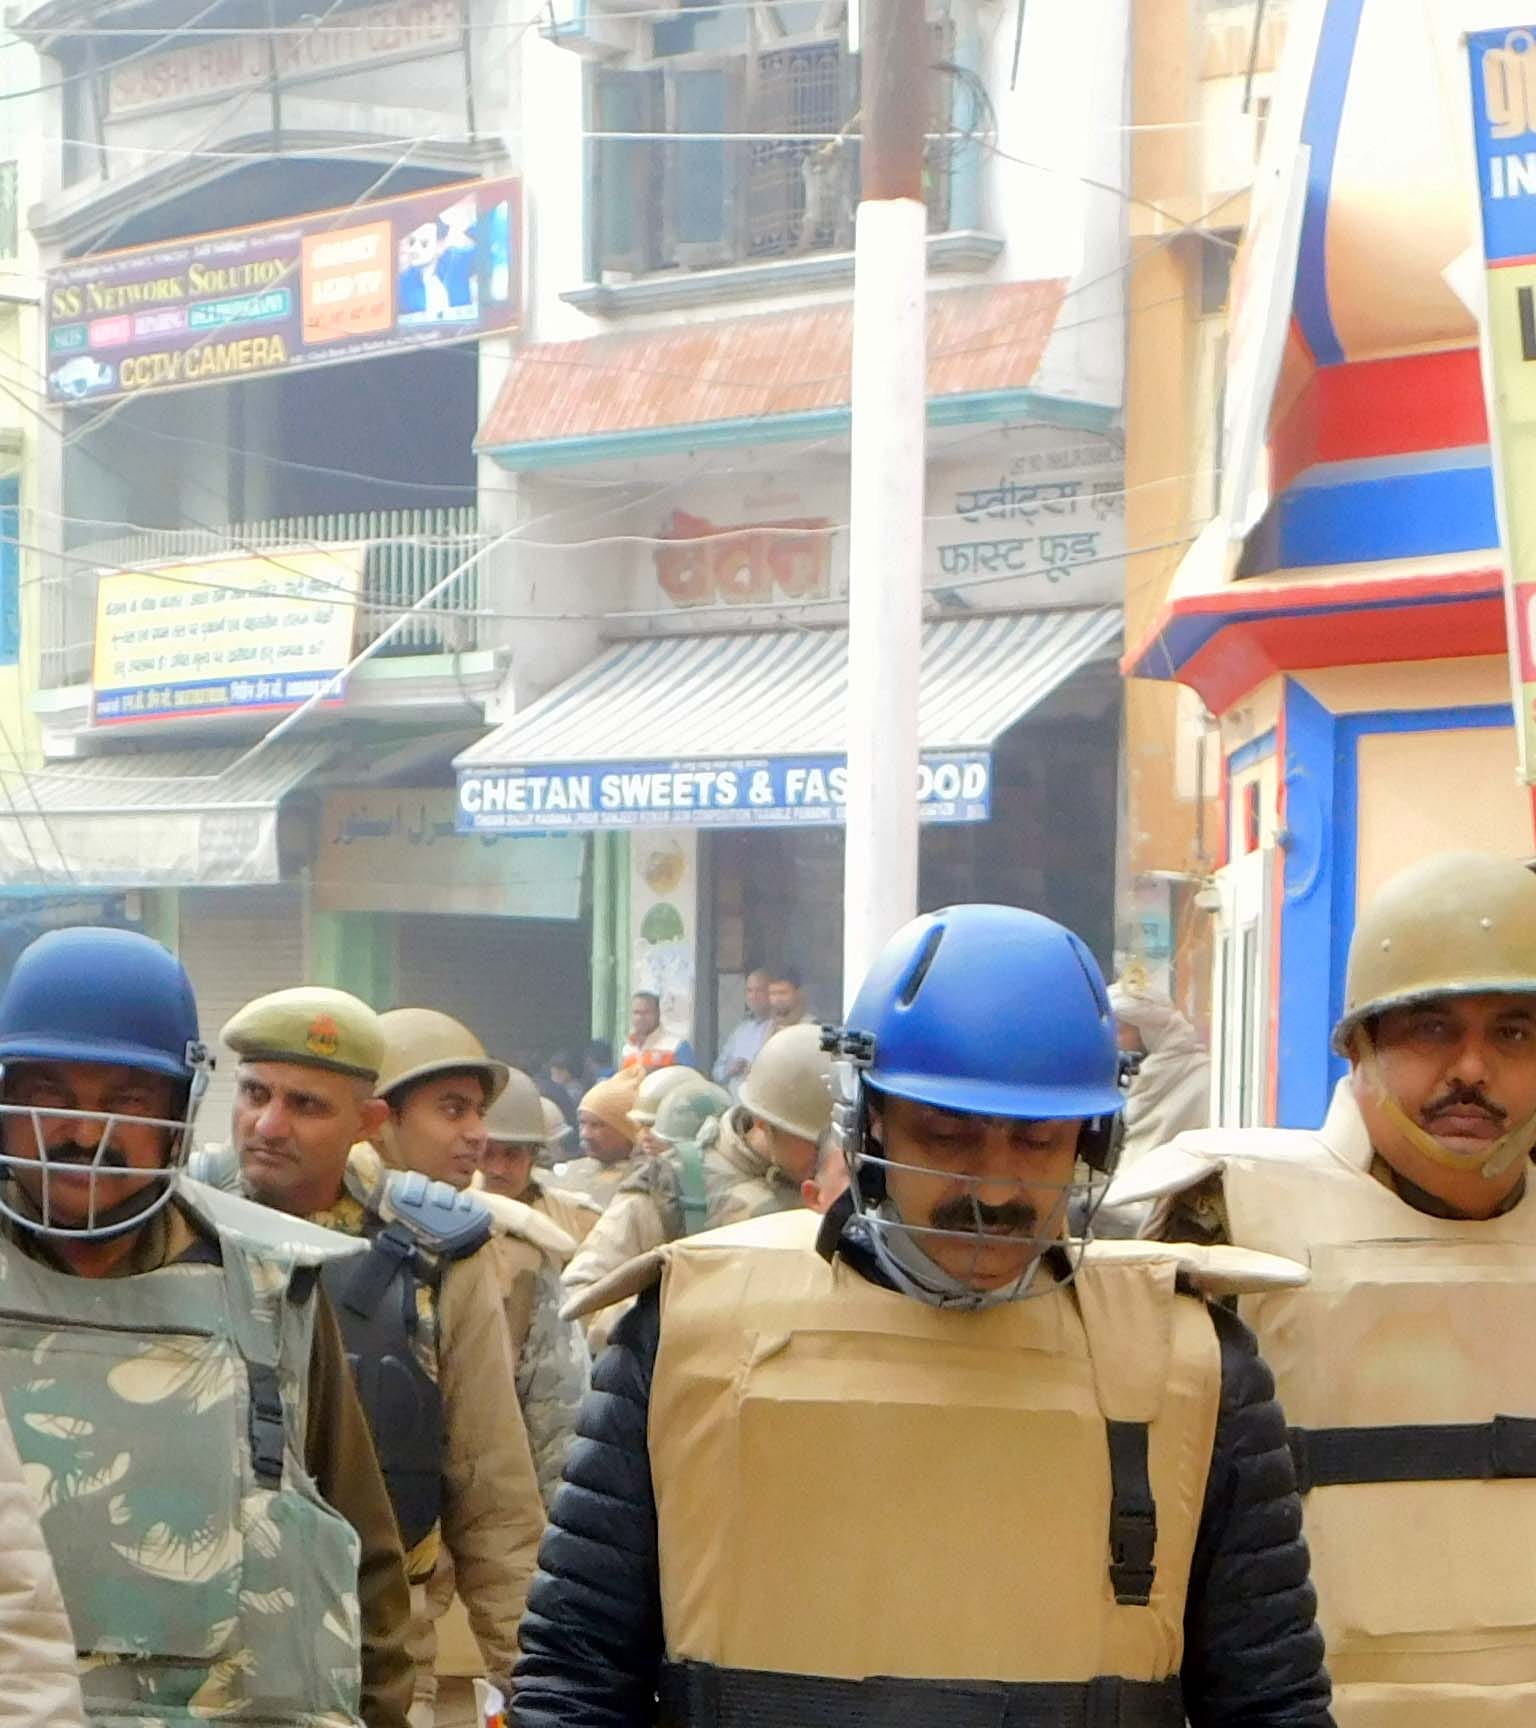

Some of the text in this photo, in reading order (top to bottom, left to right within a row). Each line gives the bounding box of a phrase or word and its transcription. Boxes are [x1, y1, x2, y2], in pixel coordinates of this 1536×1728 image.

[184, 334, 287, 375] CAMERA
[938, 531, 1101, 583] फास्ट फूड
[460, 762, 987, 812] CHETAN SWEETS & FAS OOD
